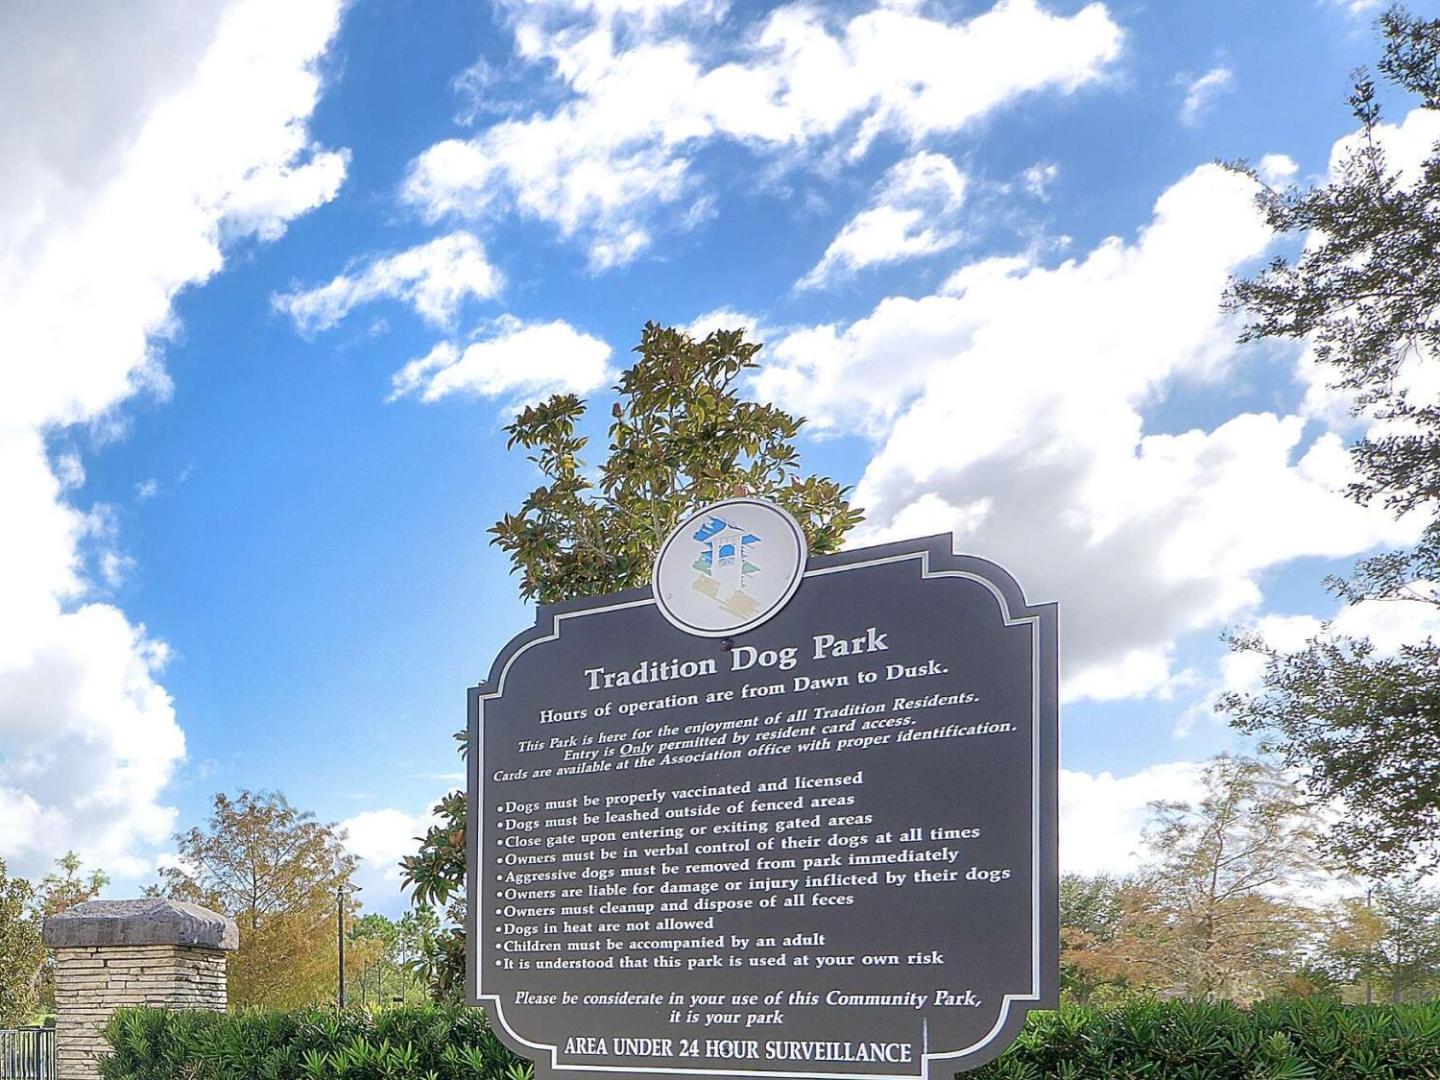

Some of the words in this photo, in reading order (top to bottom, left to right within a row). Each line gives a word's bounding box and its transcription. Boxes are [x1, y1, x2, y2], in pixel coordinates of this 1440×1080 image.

[584, 658, 717, 690] Tradition
[731, 646, 798, 671] Dog
[812, 627, 889, 660] Park
[540, 709, 587, 724] Hours
[594, 702, 612, 717] of
[618, 695, 699, 716] operation
[706, 691, 734, 703] are
[741, 684, 786, 699] from
[793, 676, 849, 692] Dawn
[857, 671, 878, 684] to
[886, 659, 949, 680] Dusk.
[518, 740, 545, 752] This
[549, 736, 578, 749] Park
[581, 735, 593, 745] is
[598, 732, 627, 743] here
[631, 728, 653, 740] for
[658, 725, 679, 737] the
[684, 716, 759, 735] enjoyment
[764, 712, 782, 725] of
[786, 709, 808, 723] all
[814, 703, 886, 719] Tradition
[892, 692, 980, 711] Residents.
[563, 749, 599, 761] Entry
[603, 746, 615, 757] is
[620, 741, 654, 758] Only
[658, 733, 727, 754] permitted
[732, 732, 750, 745] by
[755, 725, 816, 741] resident
[822, 719, 857, 734] card
[861, 716, 916, 730] access.
[493, 769, 528, 781] Cards
[532, 769, 552, 778] are
[556, 760, 612, 776] available
[616, 759, 629, 769] at
[634, 756, 656, 768] the
[659, 749, 742, 765] Association
[747, 743, 791, 757] office
[797, 737, 831, 752] with
[836, 735, 891, 751] proper
[896, 722, 1017, 742] identification.
[505, 801, 540, 814] Dogs
[545, 798, 578, 810] must
[583, 795, 600, 806] be
[606, 789, 666, 808] properly
[671, 781, 751, 799] vaccinated
[757, 778, 788, 792] and
[795, 771, 863, 789] licensed
[505, 819, 540, 831] Dogs
[545, 815, 578, 827] must
[583, 813, 600, 824] be
[605, 807, 660, 823] leashed
[665, 803, 720, 818] outside
[726, 800, 744, 813] of
[751, 796, 804, 812] fenced
[810, 796, 855, 808] areas
[505, 836, 541, 847] Close
[547, 834, 575, 848] gate
[581, 833, 616, 845] upon
[622, 826, 684, 840] entering
[690, 826, 707, 835] or
[713, 820, 769, 834] exiting
[775, 814, 821, 833] gated
[828, 815, 873, 826] areas
[505, 853, 556, 865] Owners
[562, 850, 595, 862] must
[601, 848, 617, 859] be
[623, 847, 638, 858] in
[644, 843, 689, 857] verbal
[695, 838, 750, 854] control
[757, 837, 775, 850] of
[781, 836, 821, 849] their
[827, 833, 868, 848] dogs
[875, 832, 893, 843] at
[899, 827, 923, 842] all
[930, 827, 980, 840] times
[505, 869, 576, 885] Aggressive
[581, 867, 615, 880] dogs
[620, 865, 656, 877] must
[661, 863, 679, 875] be
[685, 858, 750, 873] removed
[756, 857, 796, 870] from
[803, 853, 842, 871] park
[848, 847, 959, 865] immediately
[505, 888, 556, 900] Owners
[561, 889, 583, 897] are
[588, 883, 627, 896] liable
[632, 882, 655, 894] for
[660, 881, 719, 895] damage
[725, 881, 743, 891] or
[748, 877, 799, 892] injury
[805, 872, 878, 887] inflicted
[886, 871, 907, 886] by
[914, 869, 958, 883] their
[965, 867, 1011, 883] dogs
[503, 905, 555, 917] Owners
[561, 904, 594, 915] must
[600, 901, 654, 915] cleanup
[660, 898, 689, 911] and
[694, 898, 753, 912] dispose
[759, 895, 777, 908] of
[784, 893, 805, 907] all
[811, 893, 854, 906] feces
[503, 923, 538, 937] Dogs
[544, 923, 558, 933] in
[563, 921, 592, 933] heat
[598, 923, 620, 932] are
[626, 921, 650, 931] not
[656, 917, 714, 930] allowed
[504, 940, 561, 952] Children
[567, 940, 601, 950] must
[606, 938, 623, 950] be
[629, 935, 725, 952] accompanied
[731, 935, 750, 950] by
[756, 938, 776, 947] an
[782, 933, 825, 946] adult
[504, 958, 514, 969] It
[519, 958, 530, 969] is
[536, 957, 614, 969] understood
[619, 956, 648, 968] that
[654, 955, 681, 967] this
[687, 955, 723, 970] park
[729, 955, 742, 967] is
[748, 953, 786, 966] used
[793, 955, 809, 966] at
[815, 956, 855, 968] your
[862, 955, 900, 965] own
[907, 950, 944, 964] risk
[515, 991, 557, 1004] Please
[562, 991, 578, 1004] be
[583, 991, 663, 1005] considerate
[668, 992, 684, 1005] in
[689, 995, 726, 1008] your
[731, 995, 758, 1005] use
[764, 990, 784, 1005] of
[788, 990, 819, 1005] this
[826, 990, 928, 1009] Community
[933, 990, 982, 1007] Park,
[669, 1010, 681, 1023] it
[686, 1010, 700, 1023] is
[705, 1014, 741, 1026] your
[745, 1010, 784, 1027] park
[564, 1037, 608, 1055] AREA
[613, 1038, 674, 1056] UNDER
[679, 1039, 699, 1057] 24
[705, 1040, 760, 1058] HOUR
[766, 1041, 912, 1062] SURVEILLANCE
